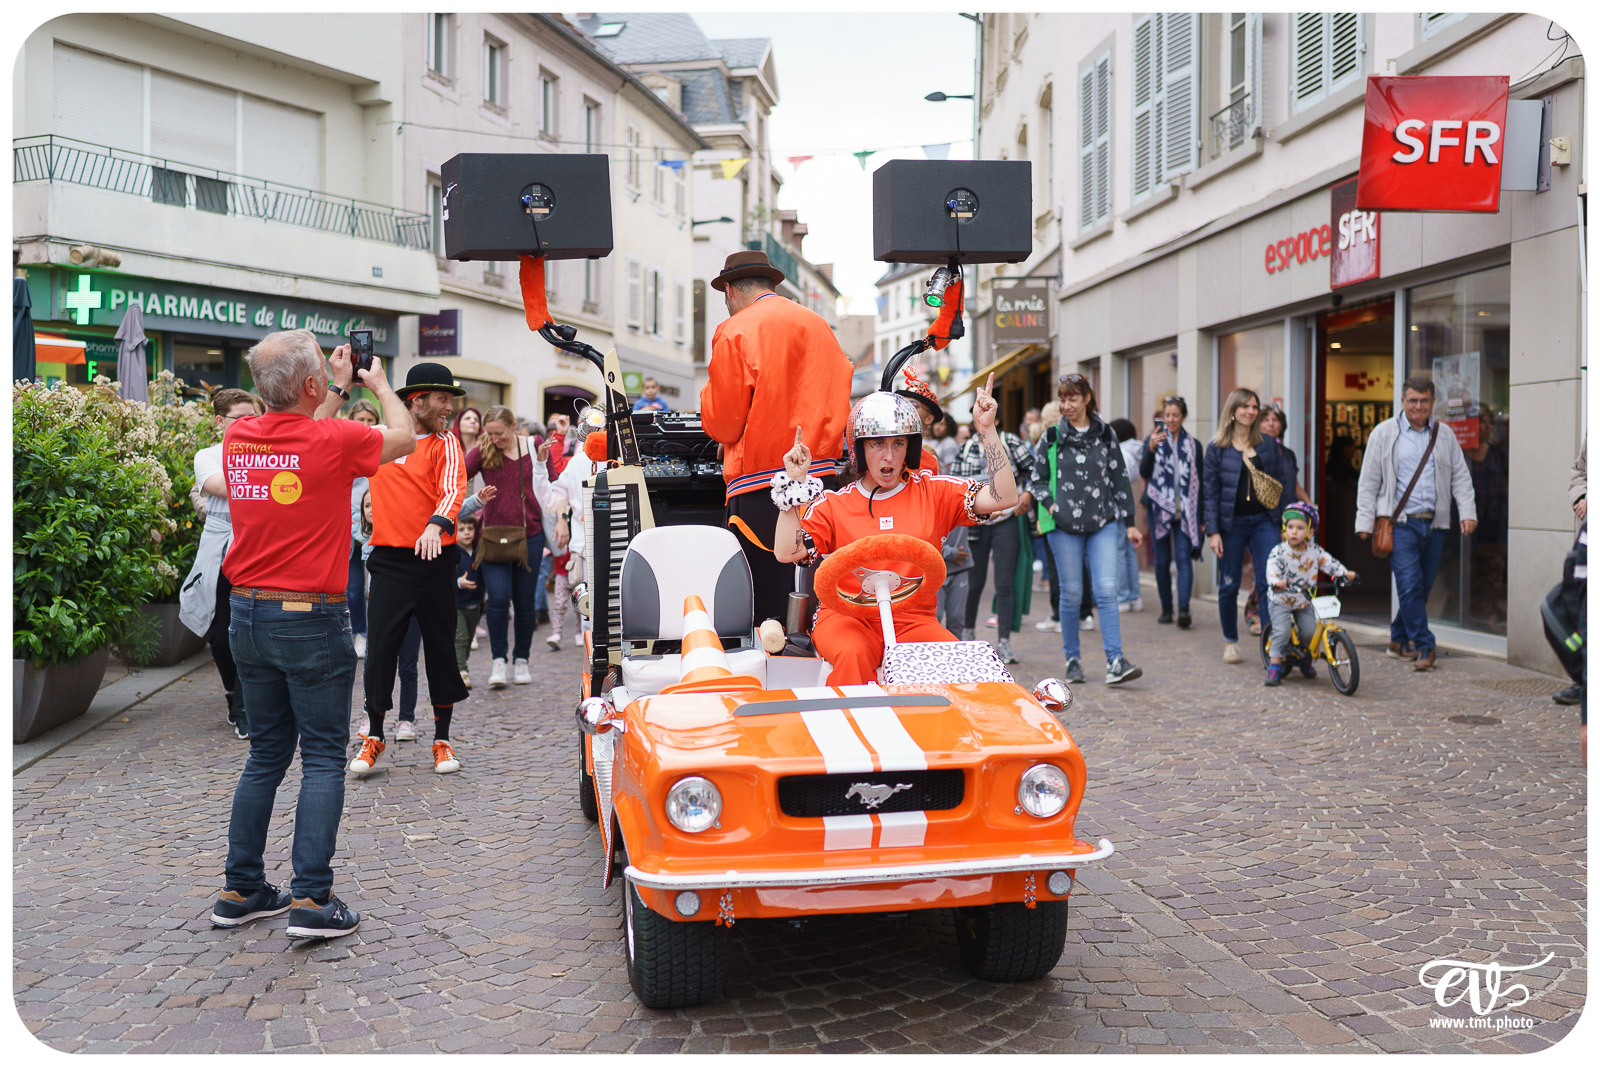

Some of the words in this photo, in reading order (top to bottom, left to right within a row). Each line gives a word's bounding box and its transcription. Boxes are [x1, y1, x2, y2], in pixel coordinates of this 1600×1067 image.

[1392, 119, 1501, 164] SFR
[1265, 223, 1331, 275] espace
[1338, 209, 1377, 251] SFR
[996, 294, 1013, 312] la
[1013, 294, 1047, 312] mie
[110, 288, 247, 324] PHARMACIE
[254, 306, 274, 327] de
[281, 308, 297, 330] la
[304, 313, 340, 335] place
[86, 342, 121, 353] pharm
[227, 442, 275, 454] FESTIVAL
[227, 454, 300, 468] L'HUMOUR
[228, 470, 249, 483] DES
[230, 485, 269, 498] NOTES
